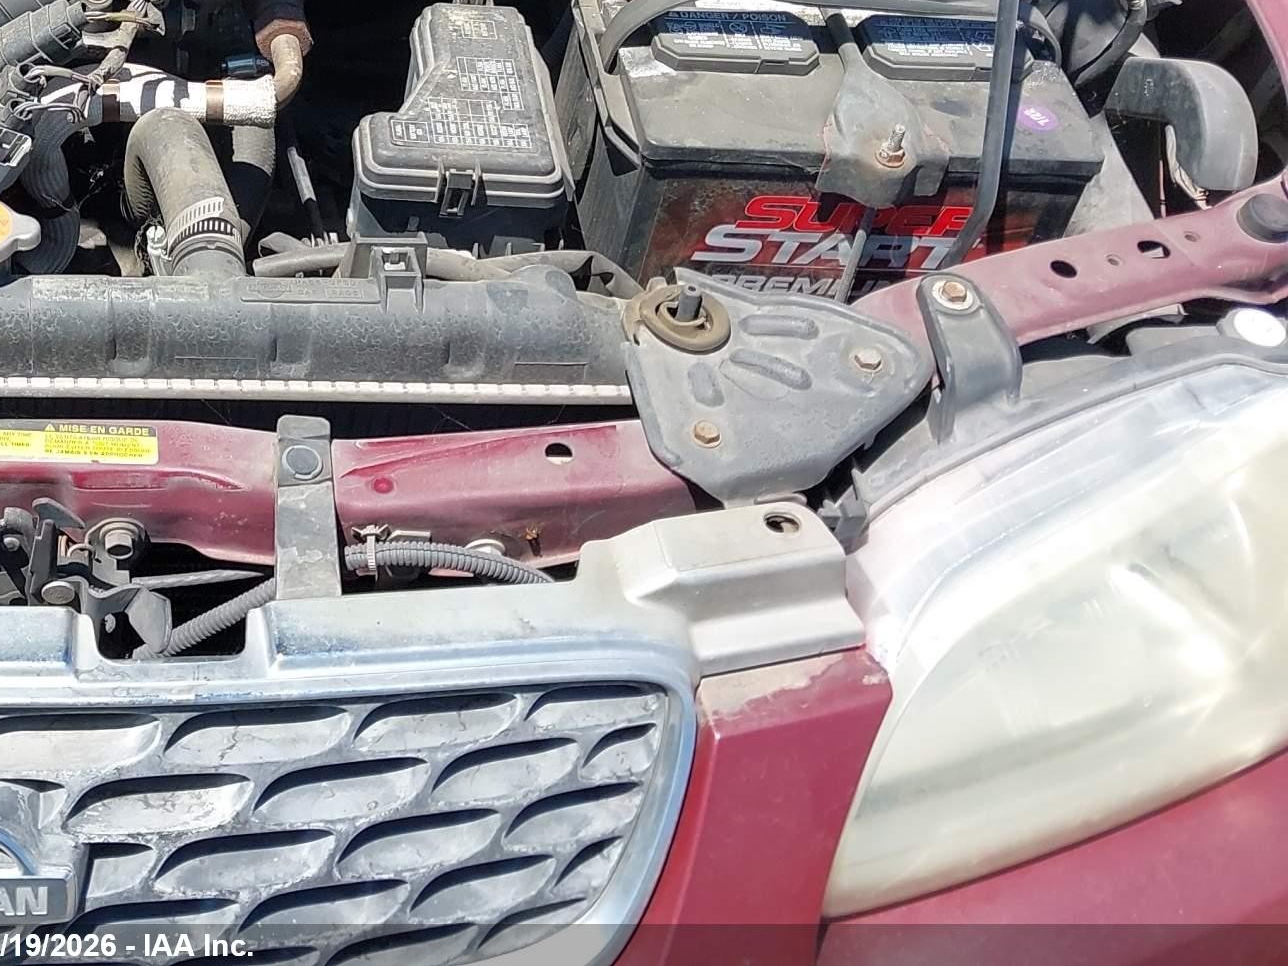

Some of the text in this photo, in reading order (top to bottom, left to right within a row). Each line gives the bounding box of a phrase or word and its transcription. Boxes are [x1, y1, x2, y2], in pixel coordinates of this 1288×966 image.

[680, 11, 729, 20] DANGER
[742, 12, 787, 22] POISON
[735, 195, 973, 237] SUPER
[691, 224, 960, 269] START
[59, 424, 149, 436] MISE EN GARDE
